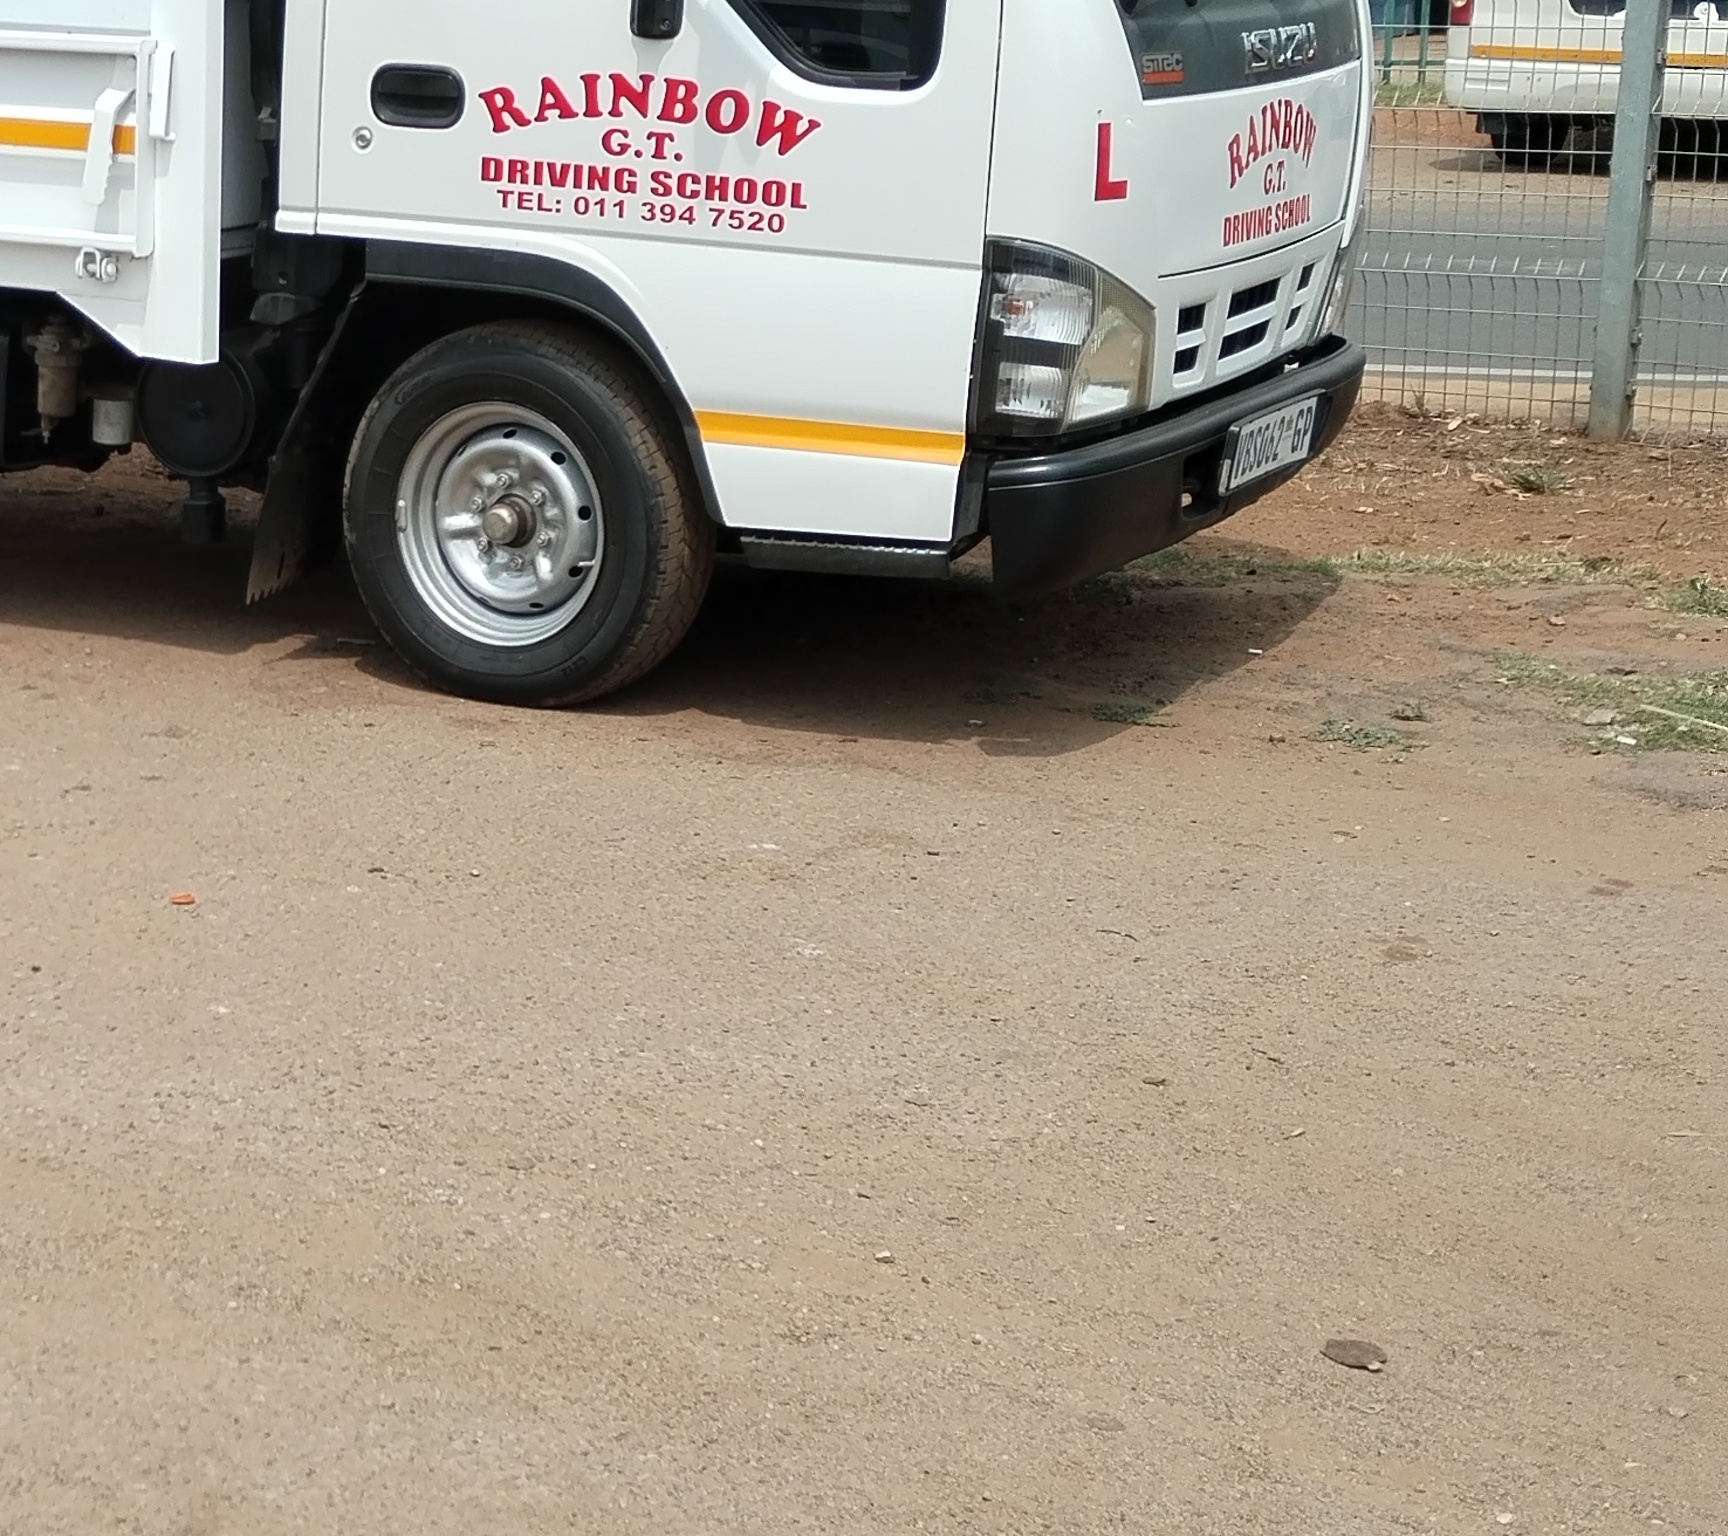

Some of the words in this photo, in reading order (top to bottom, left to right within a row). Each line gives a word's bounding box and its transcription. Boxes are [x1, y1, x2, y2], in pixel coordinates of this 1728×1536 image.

[1242, 21, 1318, 74] ISUZU
[477, 72, 822, 157] RAINBOW
[601, 128, 683, 162] G.T.
[1094, 122, 1128, 201] L
[1227, 98, 1317, 190] RAINBOW
[480, 156, 638, 195] DRIVING
[650, 170, 807, 210] SCHOOL
[1263, 159, 1287, 196] G.T.
[496, 189, 562, 214] TEL:
[573, 196, 625, 219] 011
[640, 201, 696, 225] 394
[708, 207, 785, 233] 7520
[1223, 205, 1273, 248] DRIVING
[1274, 193, 1311, 234] SCHOOL
[1290, 405, 1313, 454] GP
